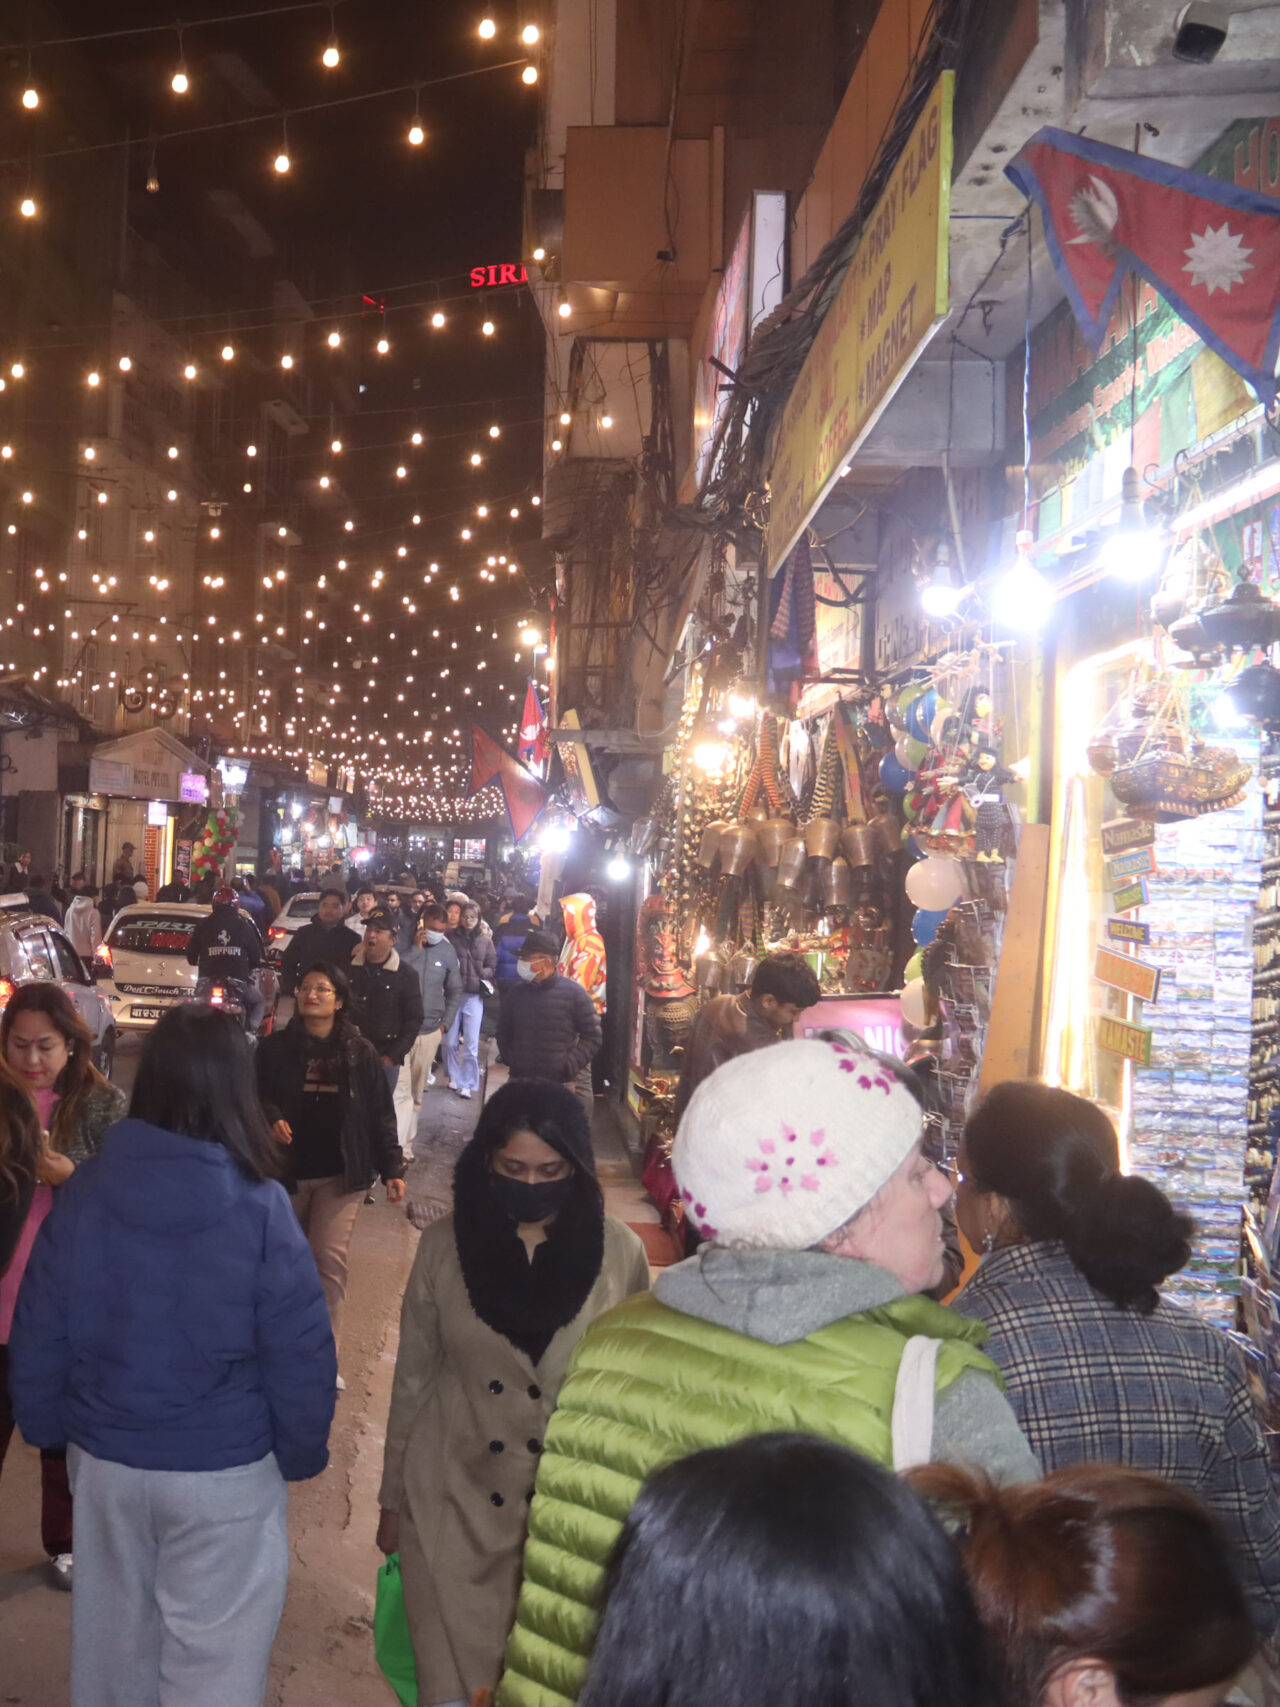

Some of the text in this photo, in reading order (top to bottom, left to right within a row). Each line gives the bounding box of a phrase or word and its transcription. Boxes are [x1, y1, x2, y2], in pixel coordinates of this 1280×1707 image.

[901, 105, 938, 212] FLAG
[867, 261, 891, 338] MAP
[865, 282, 917, 405] MAGNET
[817, 397, 850, 483] COFFEE
[1103, 822, 1153, 851] Namaste
[123, 984, 151, 995] Don't
[150, 986, 180, 995] Touch
[208, 946, 242, 957] Ferrari
